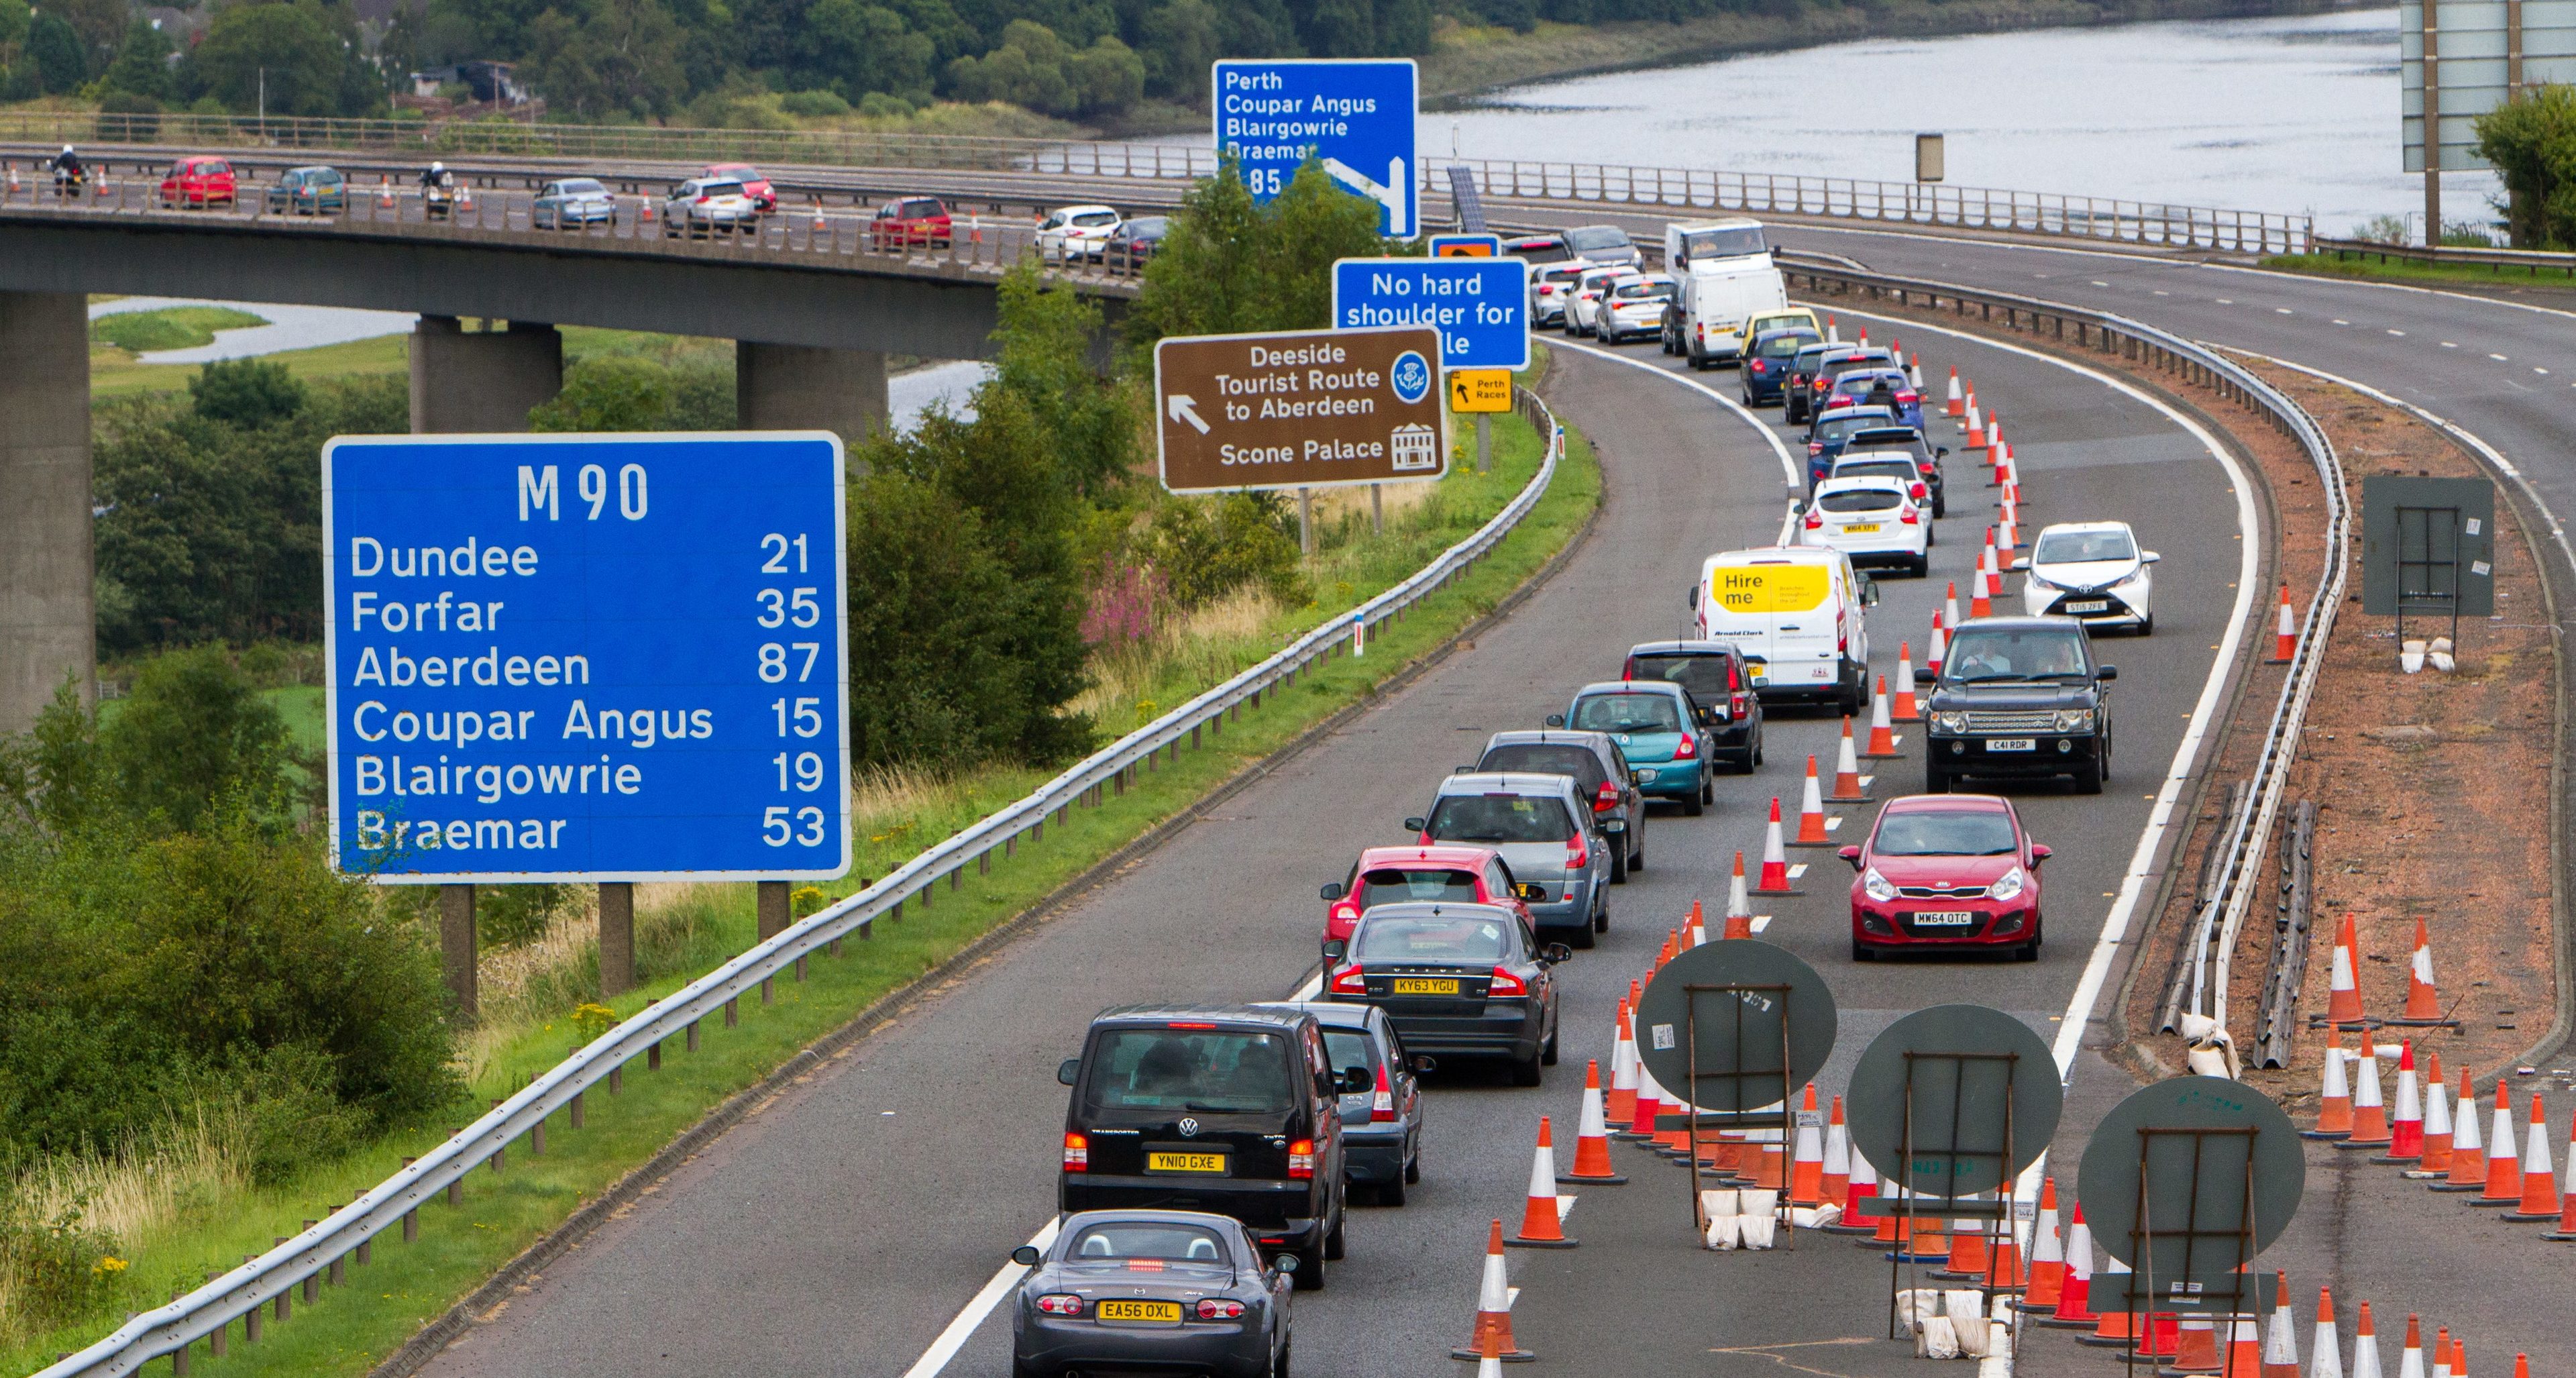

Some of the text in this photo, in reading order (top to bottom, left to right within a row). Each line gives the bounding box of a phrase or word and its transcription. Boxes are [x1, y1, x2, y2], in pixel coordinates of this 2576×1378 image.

[1226, 71, 1282, 90] Perth
[1225, 94, 1376, 116] Coupar Angus
[1226, 118, 1348, 140] Blairgowrie
[1373, 273, 1481, 295] No hard
[1347, 301, 1514, 326] shoulder for
[1446, 331, 1470, 354] le
[1250, 343, 1346, 368] Deeside
[1215, 368, 1380, 395] Tourist Route
[1477, 380, 1505, 388] Perth
[1226, 395, 1374, 421] to Aberdeen
[1220, 439, 1383, 466] Scone Palace
[518, 463, 647, 521] M 90
[352, 533, 808, 577] Dundee 21
[1725, 574, 1763, 588] Hire
[353, 587, 820, 633] Forfar 35
[1725, 593, 1754, 604] me
[354, 642, 820, 687] Aberdeen 87
[354, 697, 822, 749] Coupar Angus 15
[1994, 741, 2027, 749] C41 RDR
[356, 751, 823, 804] Blairgowrie 19
[358, 806, 824, 851] Braemar 53
[1919, 913, 1967, 923] MW64 OTC
[1399, 980, 1454, 992] KY63 YGU
[1158, 1155, 1215, 1169] YN10 GXE
[1106, 1304, 1173, 1318] EA56 OXL
